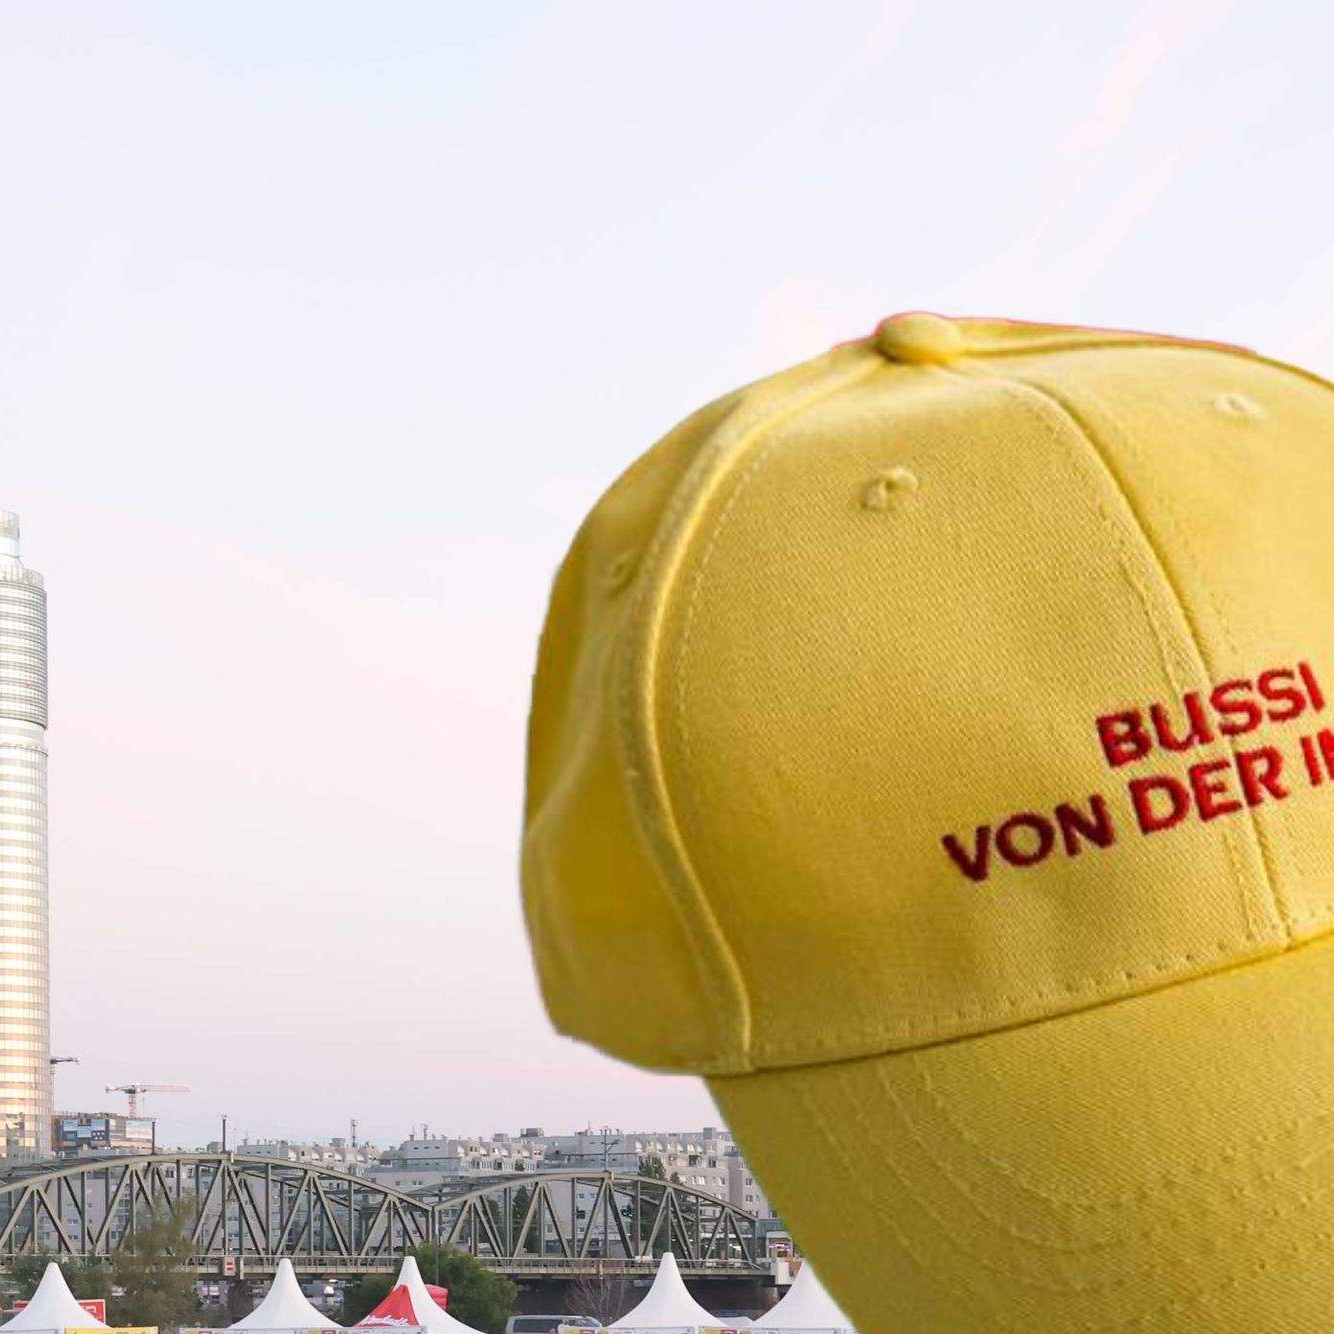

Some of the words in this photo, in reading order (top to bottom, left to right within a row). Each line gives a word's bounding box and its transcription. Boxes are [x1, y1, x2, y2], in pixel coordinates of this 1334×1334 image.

[1095, 661, 1325, 768] BUSSI
[942, 794, 1117, 882] VON
[1128, 746, 1290, 836] DER
